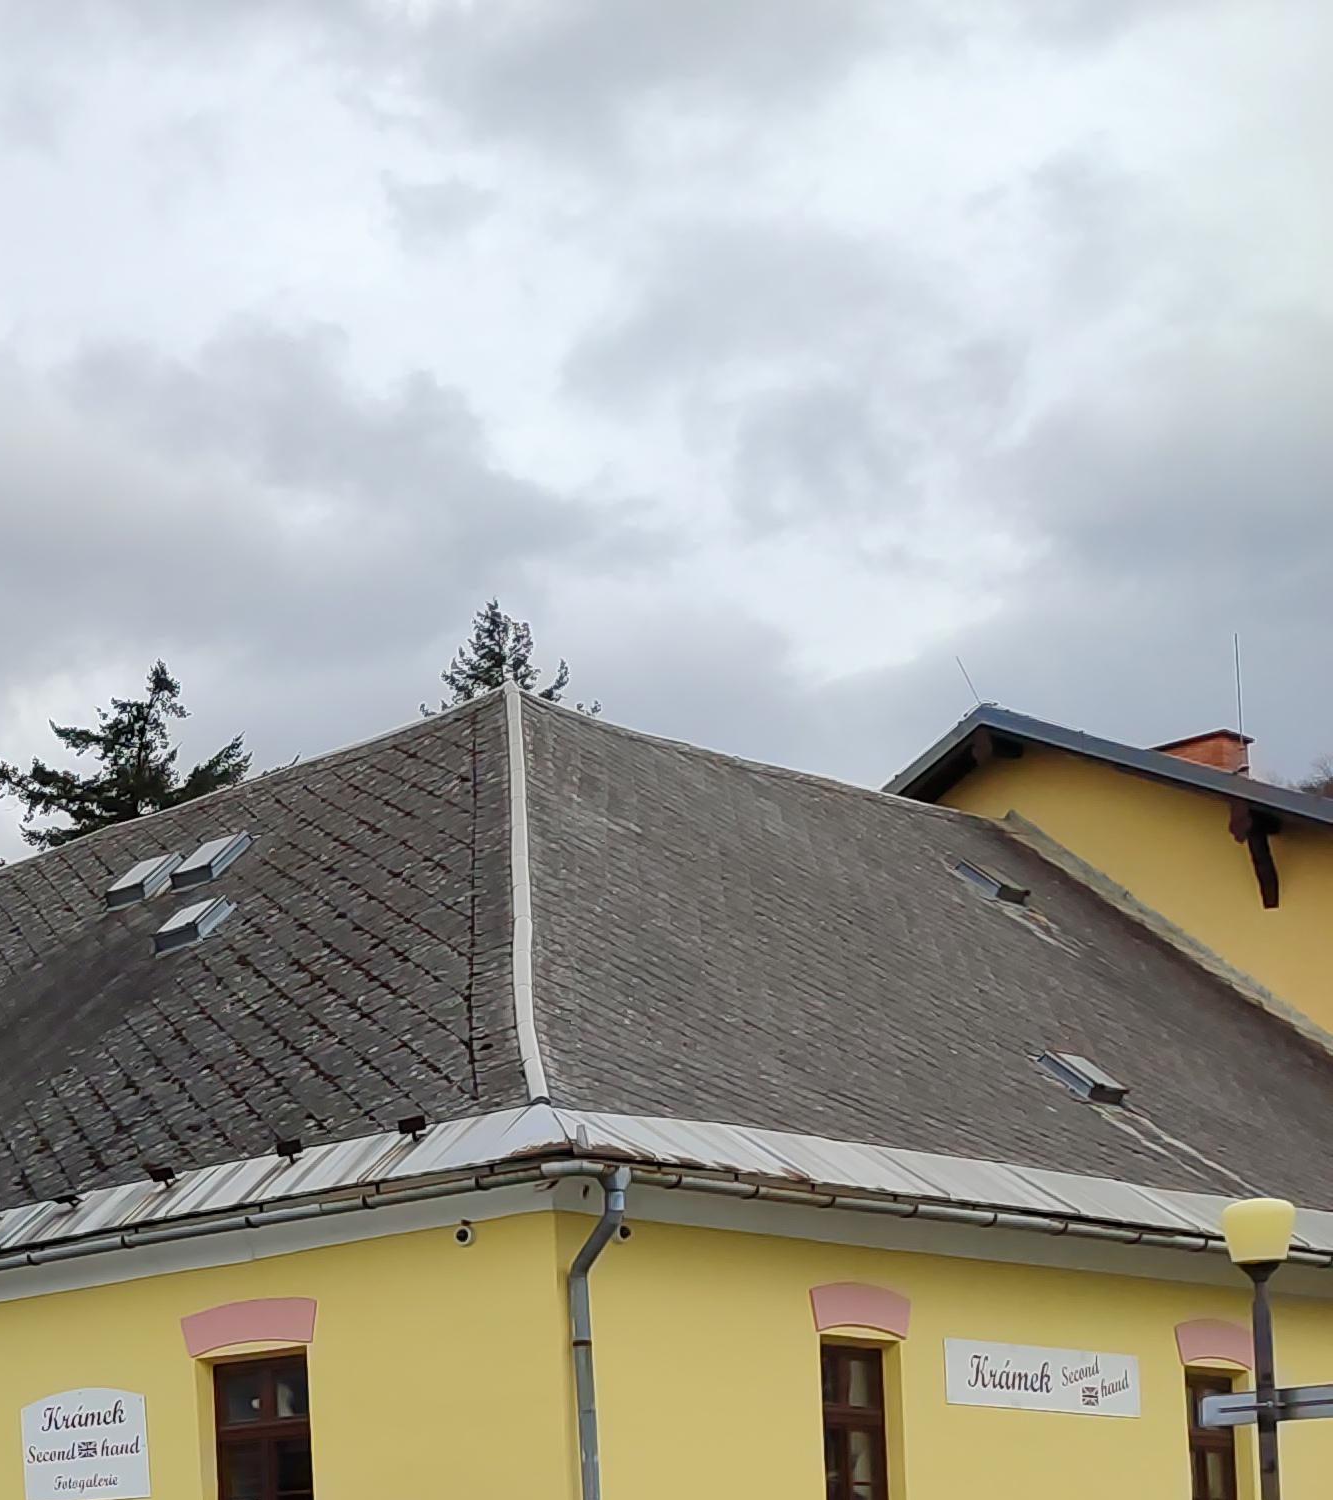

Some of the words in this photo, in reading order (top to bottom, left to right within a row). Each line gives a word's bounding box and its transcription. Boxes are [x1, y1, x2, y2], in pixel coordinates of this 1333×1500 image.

[967, 1354, 1053, 1394] Krámek
[1061, 1355, 1100, 1387] Second
[1100, 1369, 1130, 1399] hand
[41, 1399, 126, 1432] Krámek
[27, 1442, 77, 1464] Second
[100, 1435, 141, 1457] hand
[53, 1473, 118, 1493] Fotogalerie
